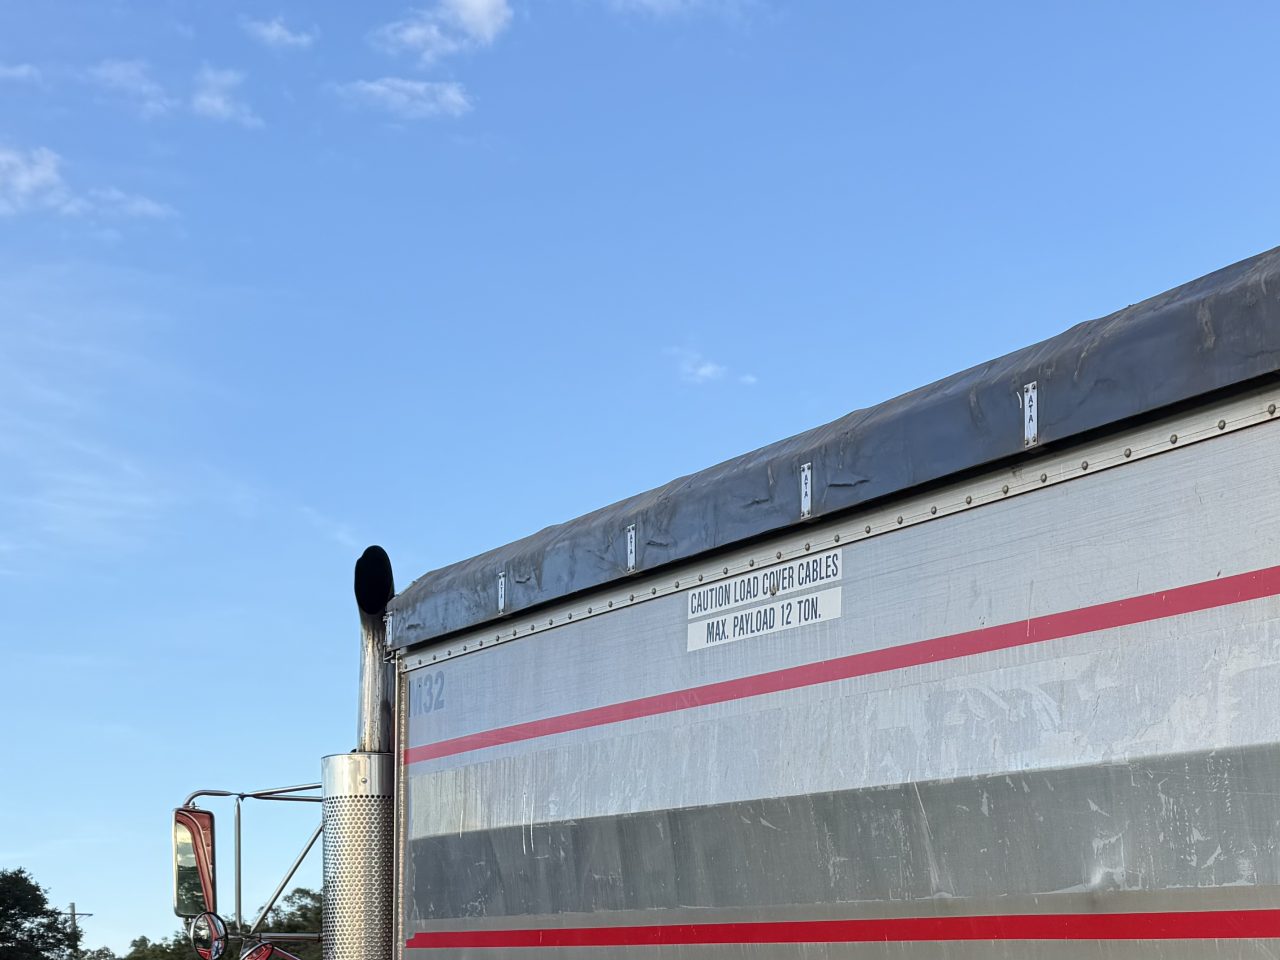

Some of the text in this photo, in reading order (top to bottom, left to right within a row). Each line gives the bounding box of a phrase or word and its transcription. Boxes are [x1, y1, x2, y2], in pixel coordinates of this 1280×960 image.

[690, 553, 839, 614] CAUTION LOAD COVER CABLES
[706, 596, 821, 644] MAX. PAYLOAD 12 TON.
